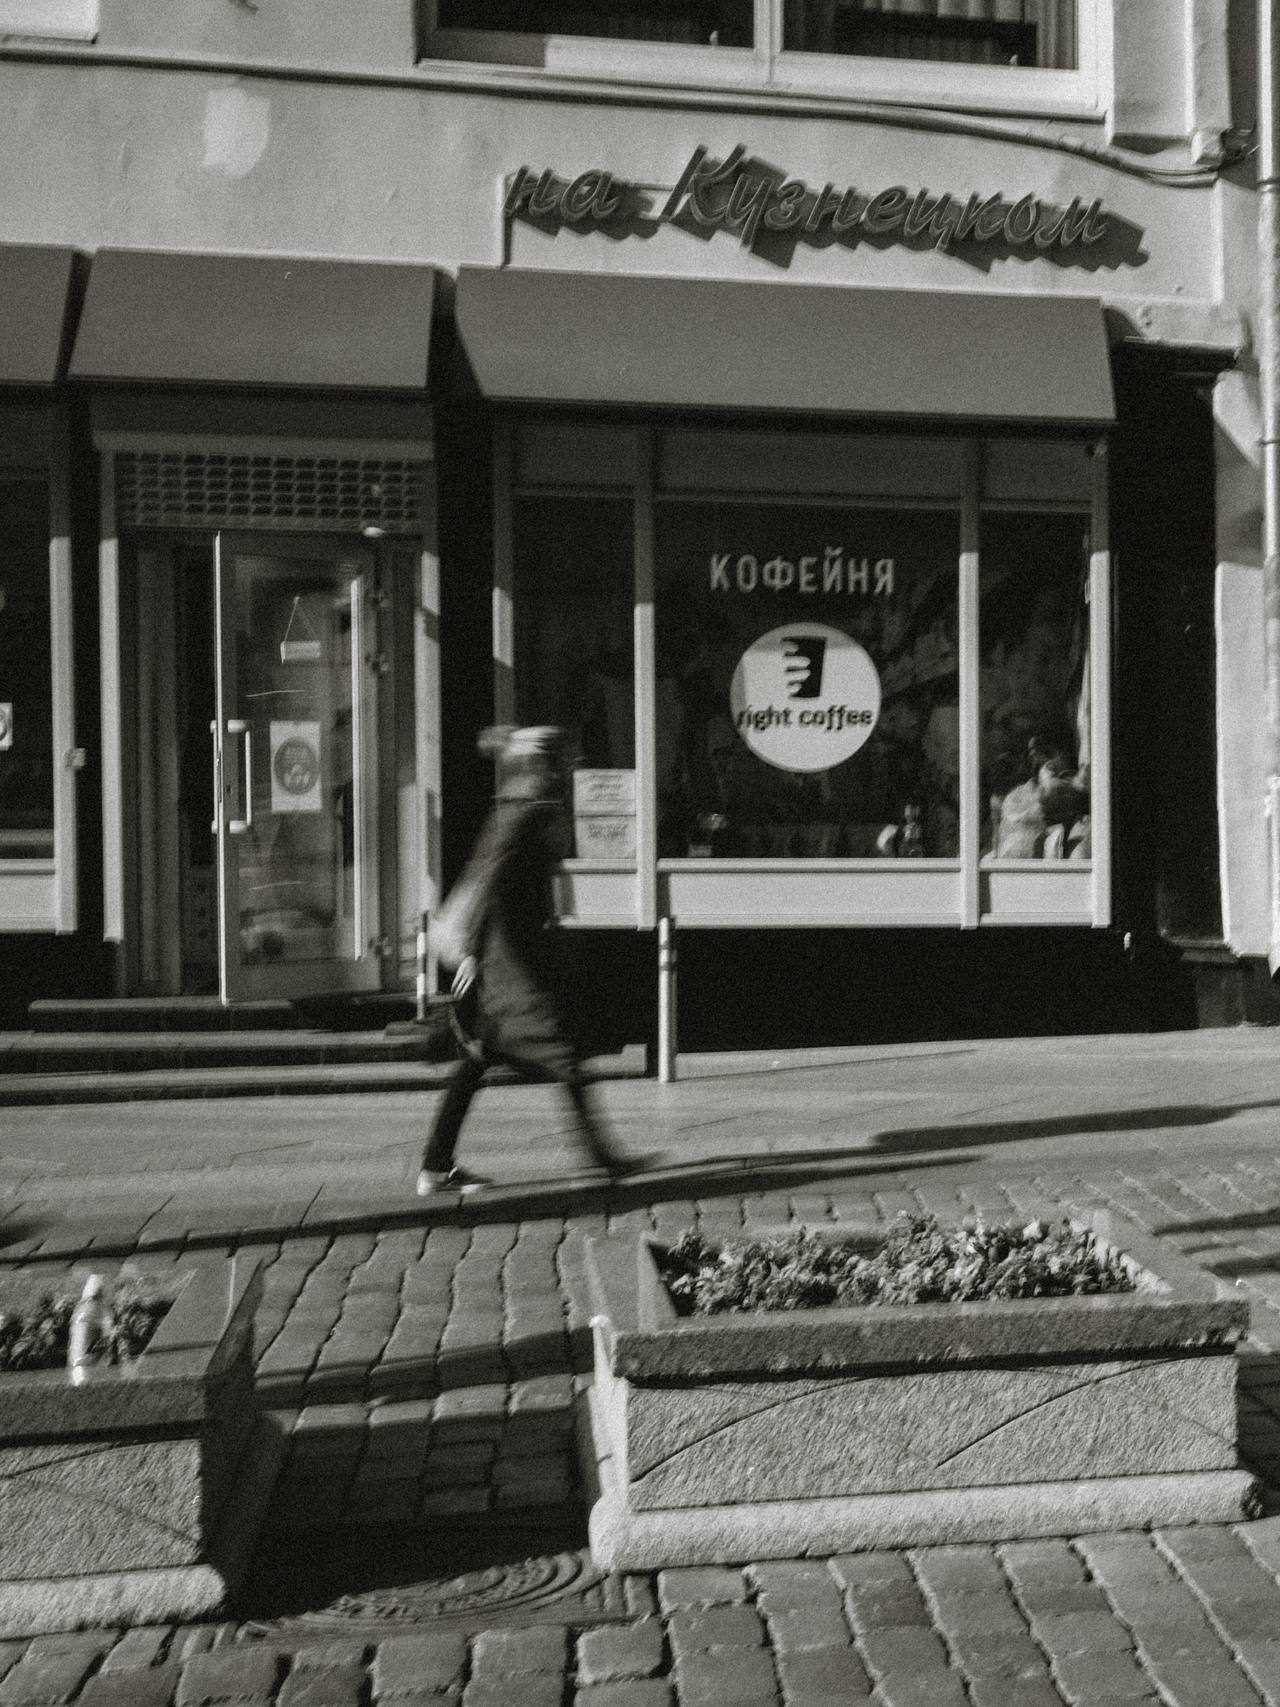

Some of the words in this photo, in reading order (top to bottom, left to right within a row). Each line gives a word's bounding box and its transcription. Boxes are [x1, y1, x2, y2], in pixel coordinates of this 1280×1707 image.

[505, 165, 622, 222] на
[660, 140, 1108, 256] Кузнецком
[709, 546, 895, 596] КОФЕЙНЯ
[736, 704, 791, 731] right
[798, 704, 873, 731] coffee
